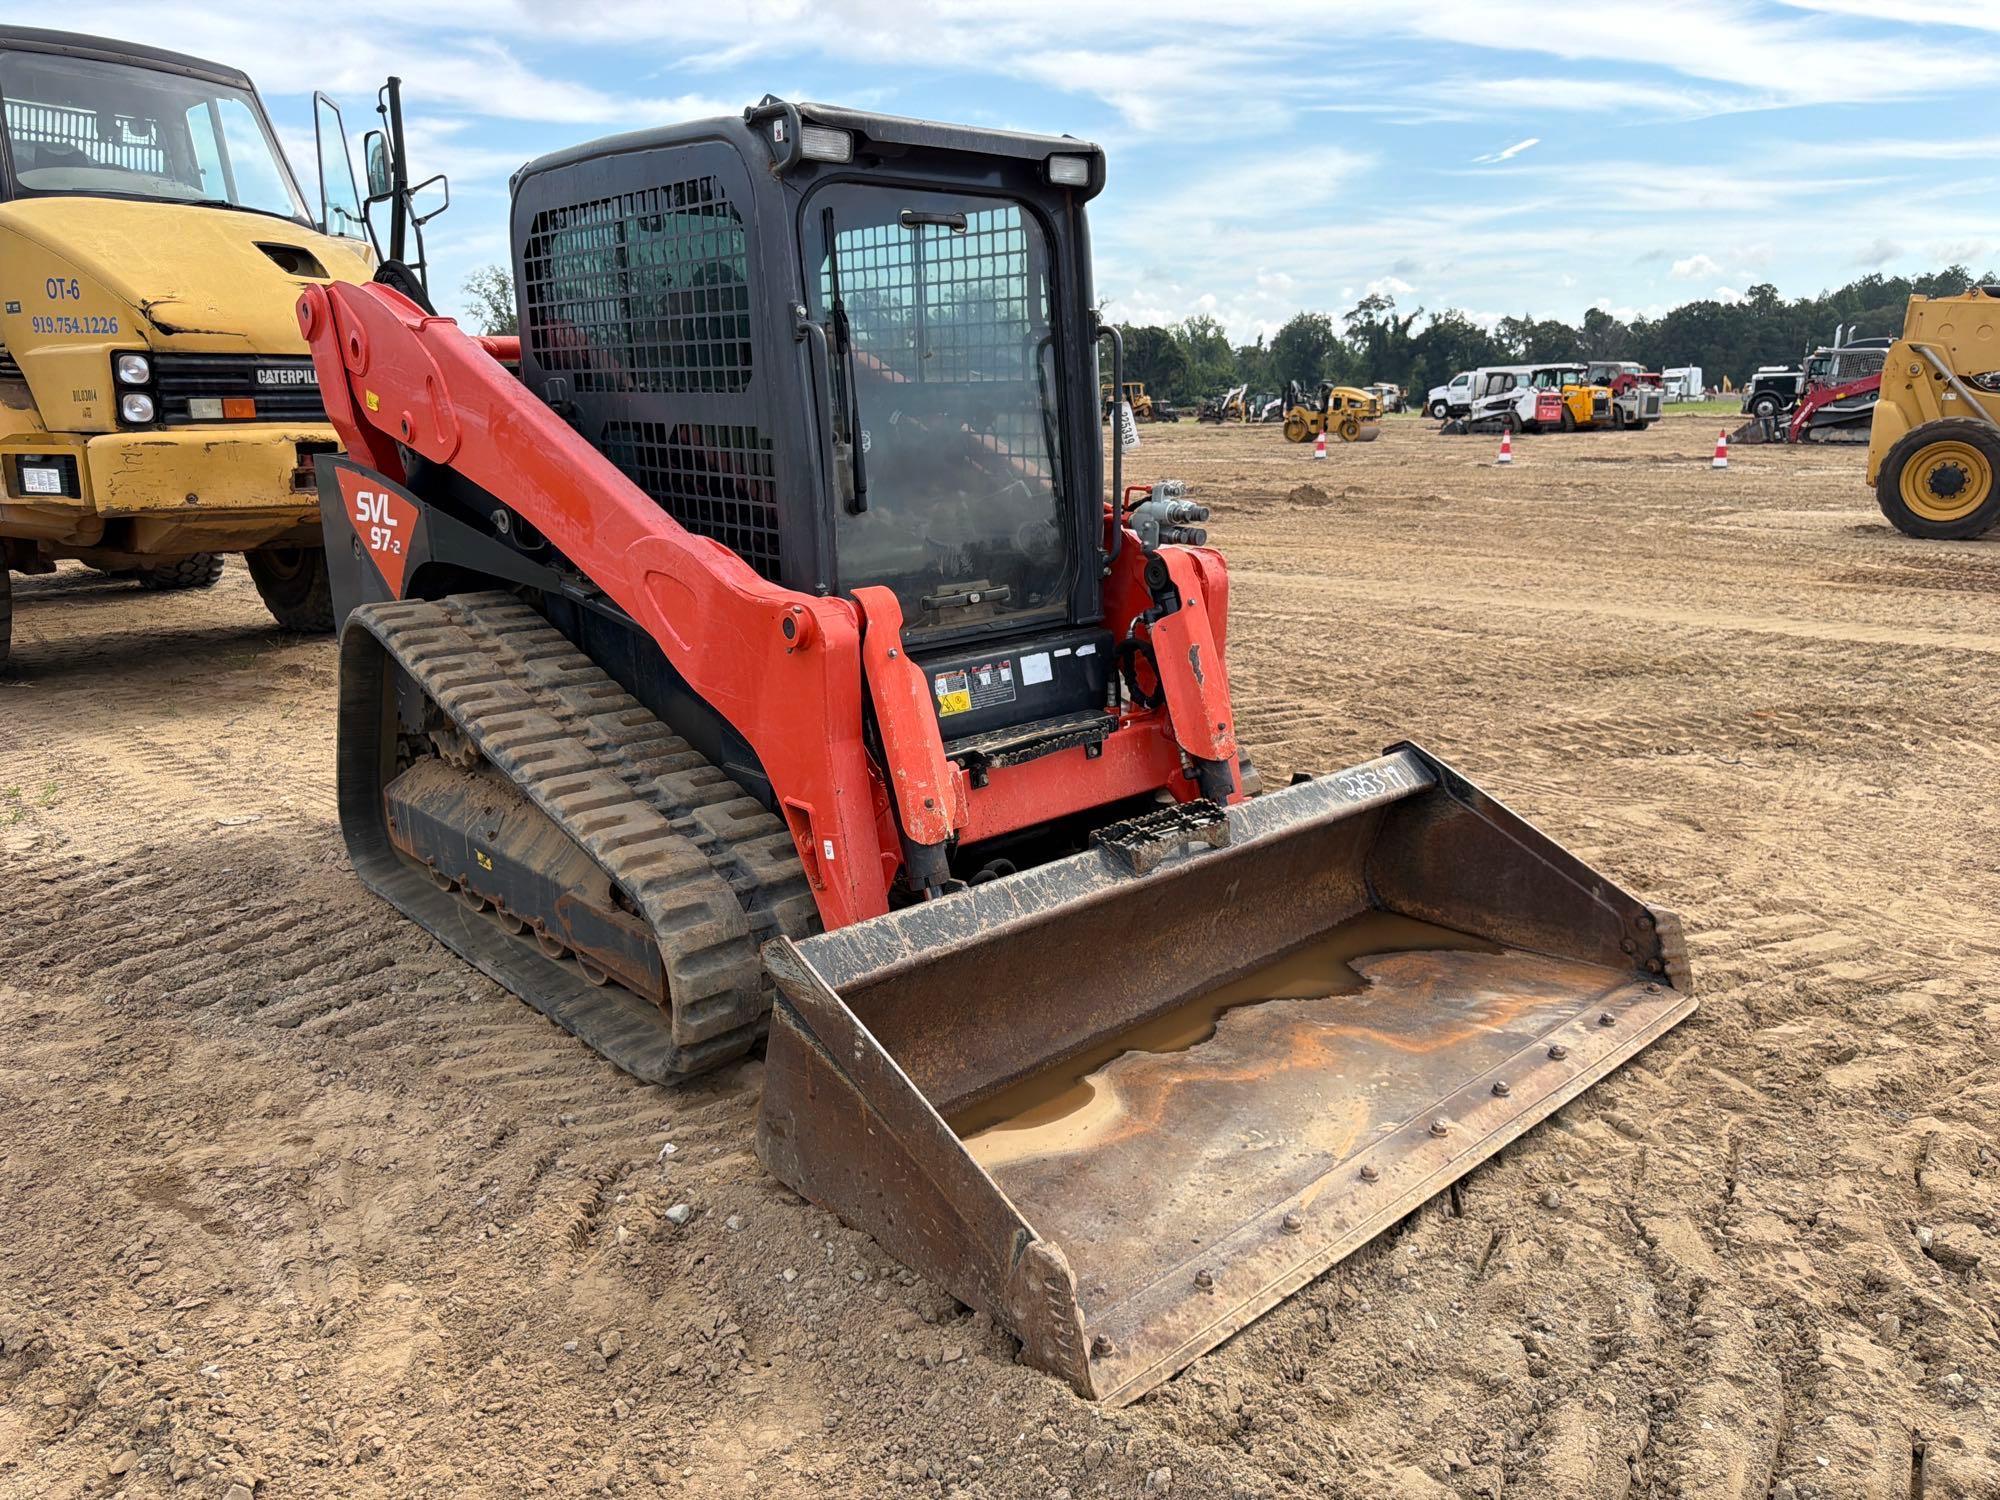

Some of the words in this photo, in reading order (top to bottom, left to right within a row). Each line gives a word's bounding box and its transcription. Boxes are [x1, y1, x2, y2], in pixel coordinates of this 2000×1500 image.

[46, 278, 80, 300] OT-6
[32, 316, 118, 334] 919.754.1226
[1121, 411, 1135, 445] 225349
[355, 491, 398, 527] SVL
[371, 526, 400, 554] 97-2
[1339, 765, 1409, 799] 225349
